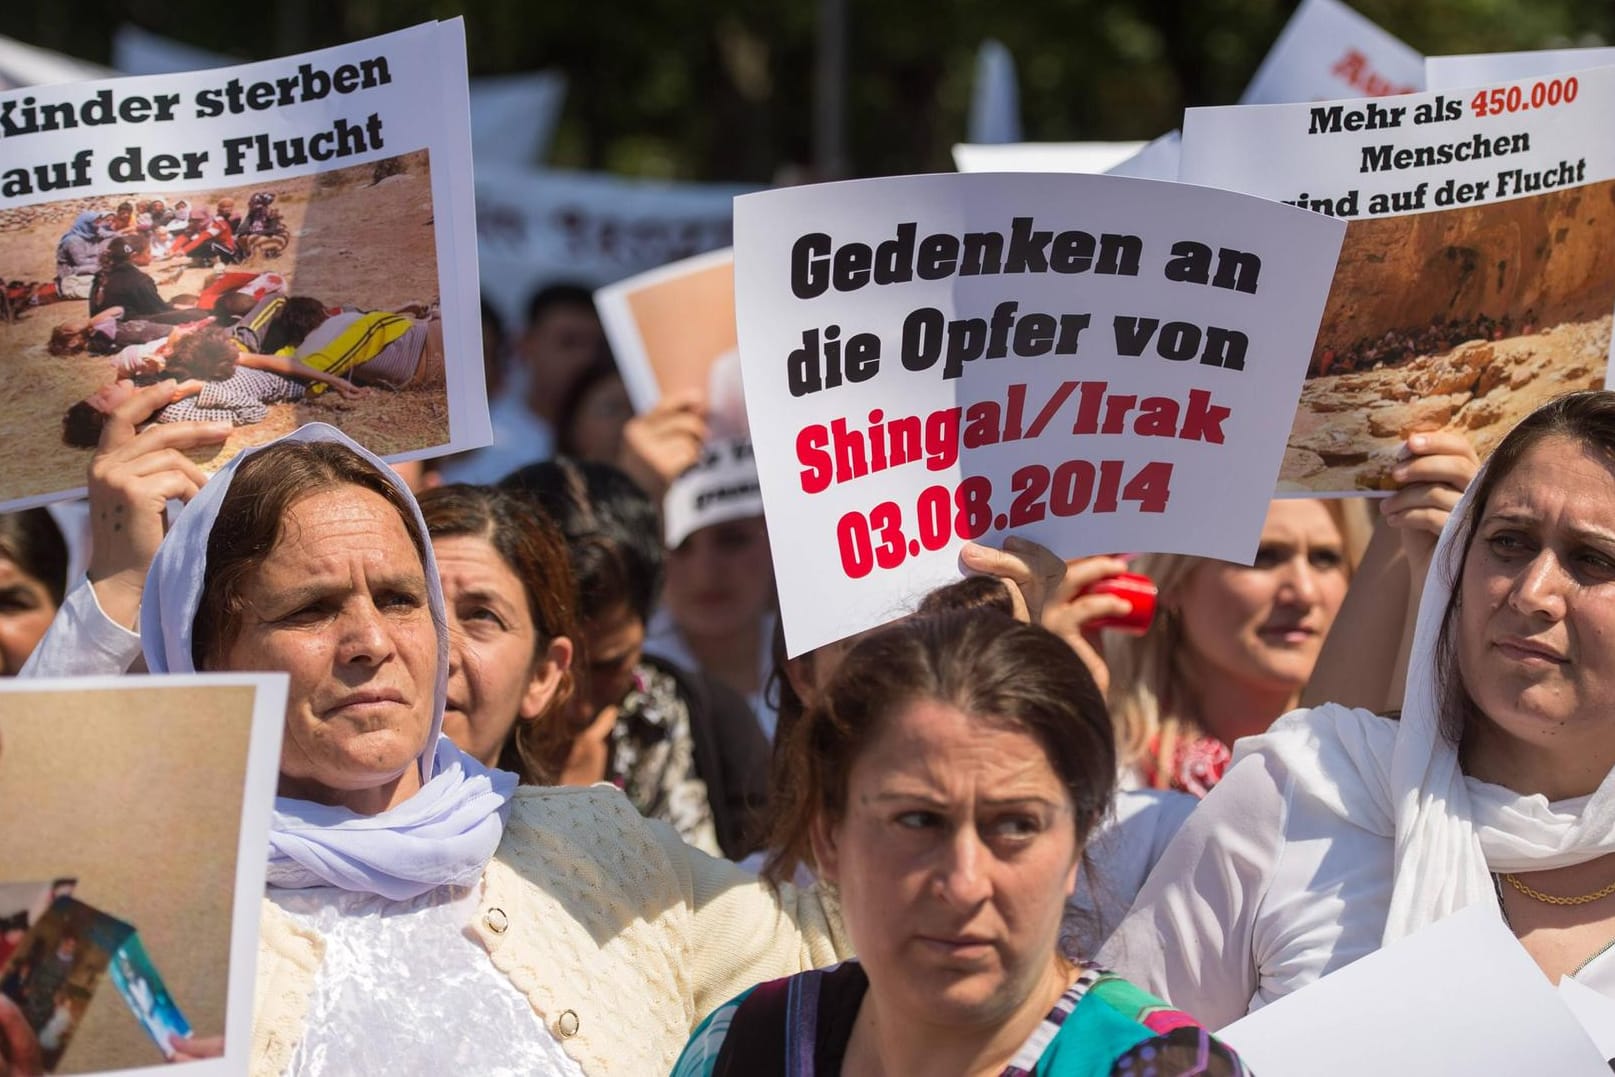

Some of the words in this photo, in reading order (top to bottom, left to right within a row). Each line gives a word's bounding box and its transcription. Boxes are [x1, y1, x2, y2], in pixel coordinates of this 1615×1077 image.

[195, 56, 391, 118] sterben
[1308, 106, 1406, 135] Mehr
[1414, 96, 1462, 125] als
[1471, 77, 1578, 117] 450.000
[2, 149, 93, 198] auf
[108, 148, 208, 182] der
[223, 113, 384, 175] Flucht
[1280, 191, 1359, 217] ind
[1369, 183, 1428, 214] auf
[1435, 180, 1490, 207] der
[1495, 158, 1585, 198] Flucht
[1361, 132, 1530, 172] Menschen
[791, 217, 1143, 299] Gedenken
[1164, 241, 1262, 295] an
[787, 325, 881, 397] die
[901, 301, 1091, 379] Opfer
[1113, 315, 1249, 371] von
[796, 380, 1231, 494] Shingal/Irak
[836, 460, 1174, 579] 03.08.2014
